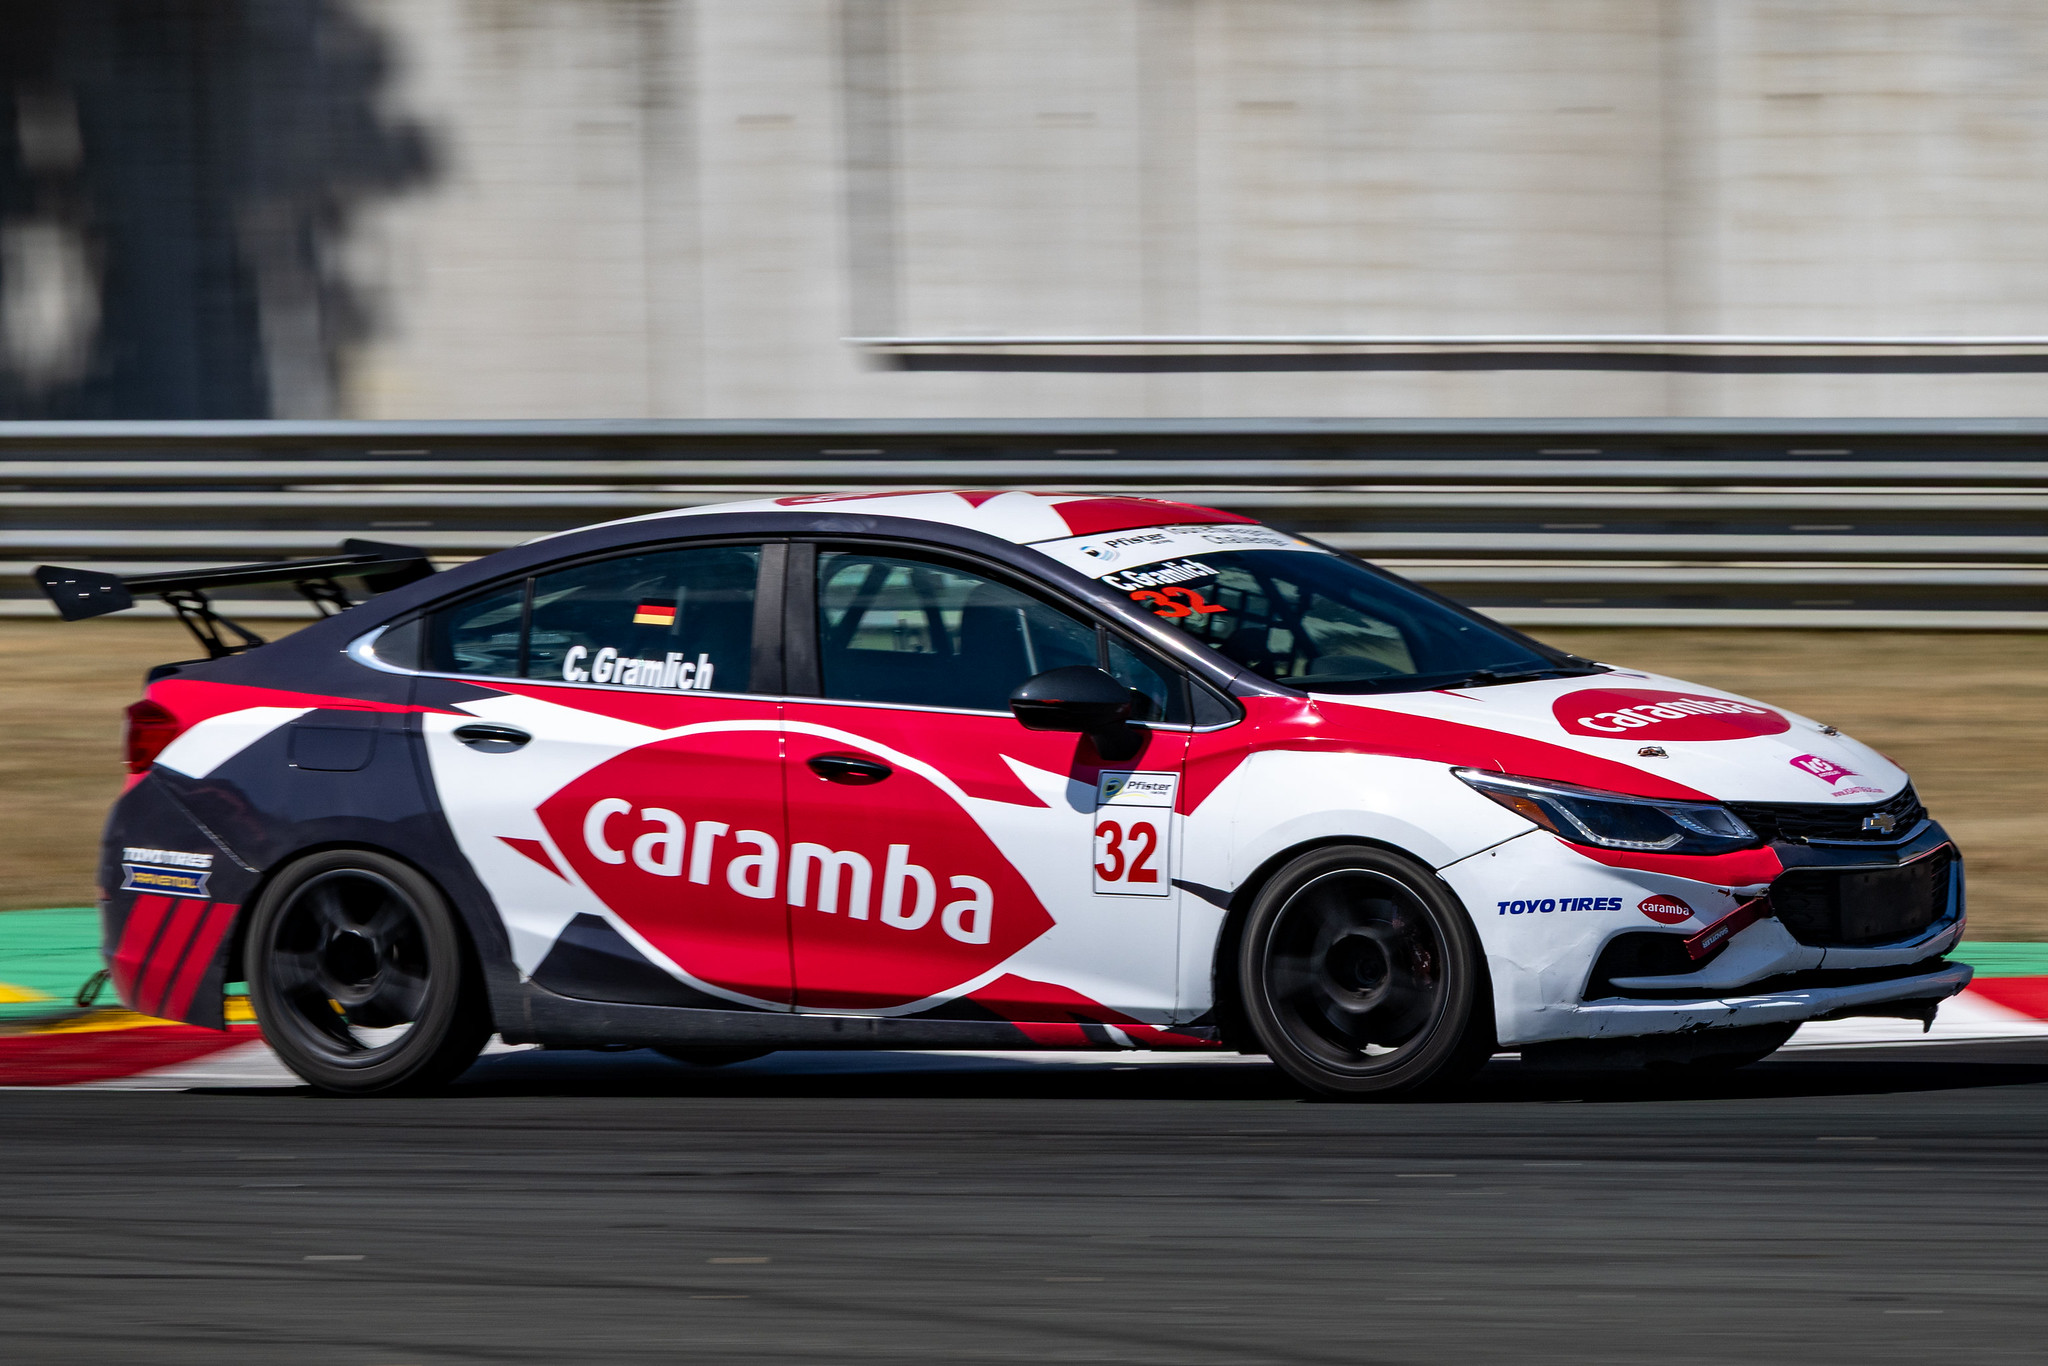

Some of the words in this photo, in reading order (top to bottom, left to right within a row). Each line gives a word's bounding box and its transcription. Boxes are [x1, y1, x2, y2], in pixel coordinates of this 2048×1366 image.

[1104, 533, 1166, 548] Pfister
[1129, 586, 1229, 618] 32
[591, 647, 714, 690] Gramlich
[1577, 698, 1768, 732] caramba
[1127, 780, 1172, 791] Pfister
[1094, 820, 1158, 883] 32
[583, 798, 994, 944] caramba
[1497, 899, 1556, 915] TOYO
[1558, 897, 1623, 912] TIRES
[1641, 902, 1690, 916] caramba
